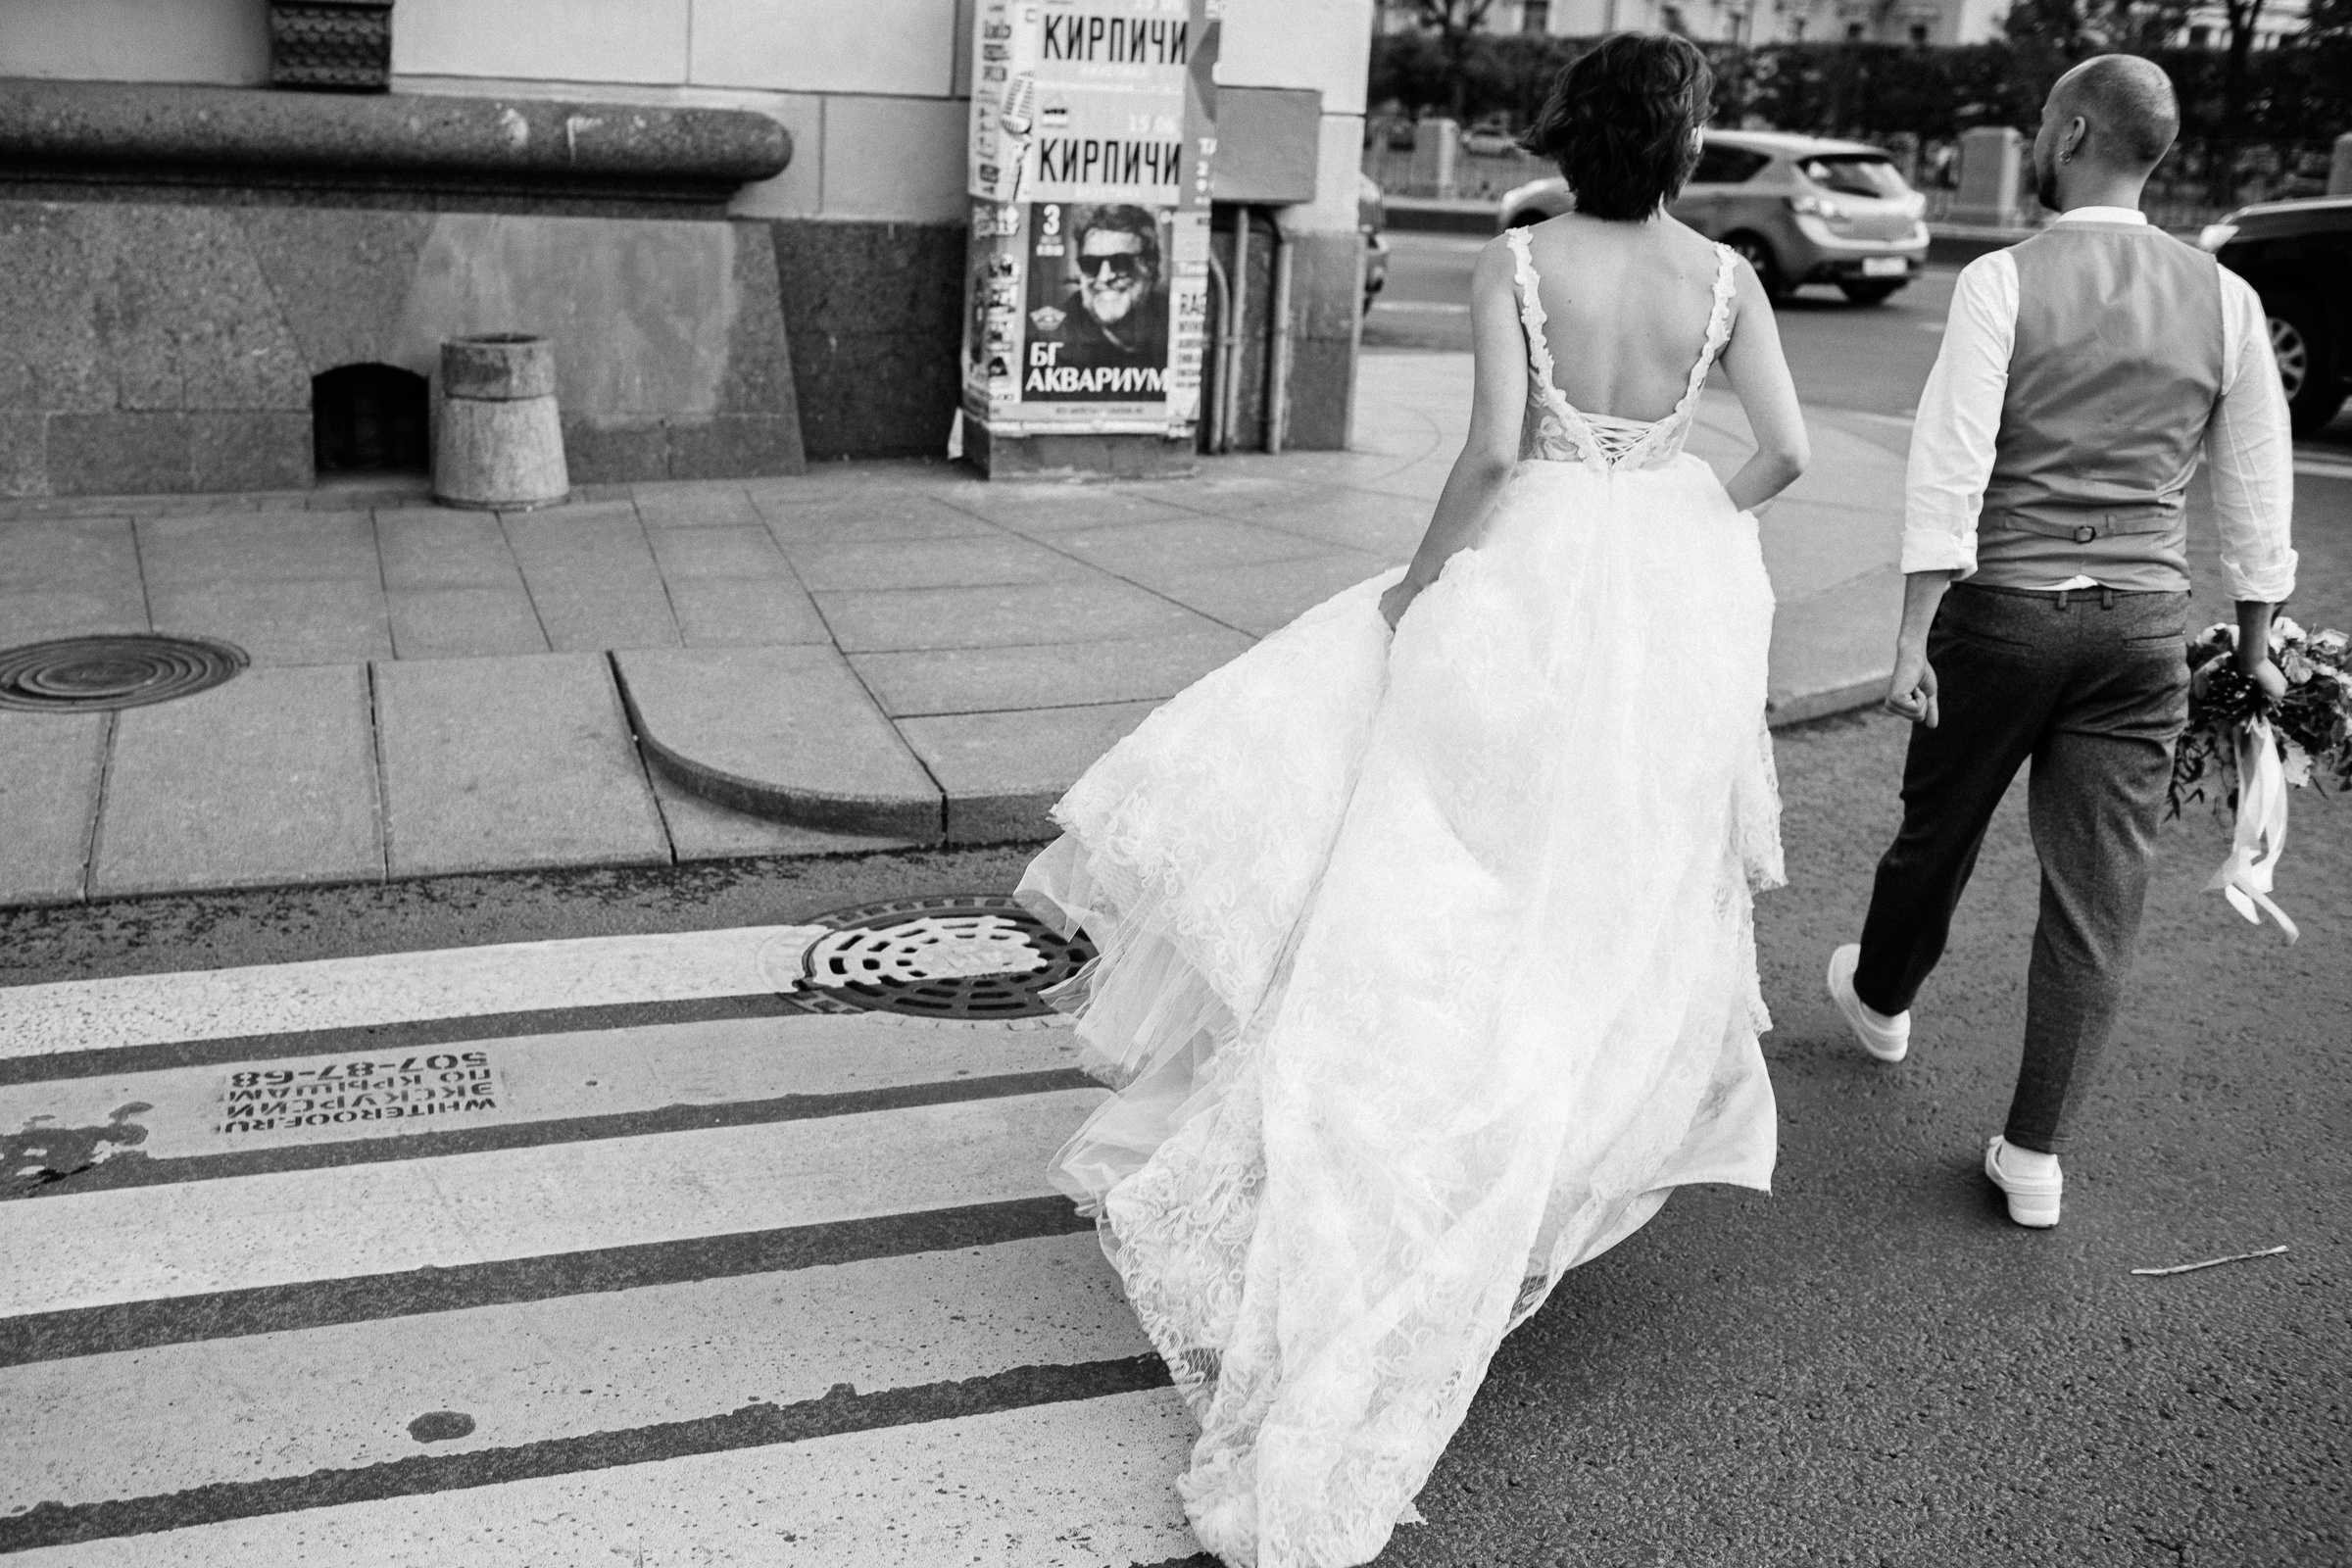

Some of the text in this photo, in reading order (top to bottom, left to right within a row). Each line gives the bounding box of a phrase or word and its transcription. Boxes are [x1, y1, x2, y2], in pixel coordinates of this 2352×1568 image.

[1044, 14, 1188, 65] КИРПИЧИ
[1039, 138, 1182, 185] КИРПИЧИ
[1043, 204, 1060, 235] 3
[1030, 342, 1064, 367] БГ
[1024, 367, 1170, 392] АКВАРИУМ
[229, 1069, 490, 1102] ПО КРЫШАМ
[231, 1052, 488, 1088] 507-87-68
[224, 1098, 496, 1133] WHITEROOF.RU
[227, 1082, 493, 1118] ЭКСКУРСИИ
